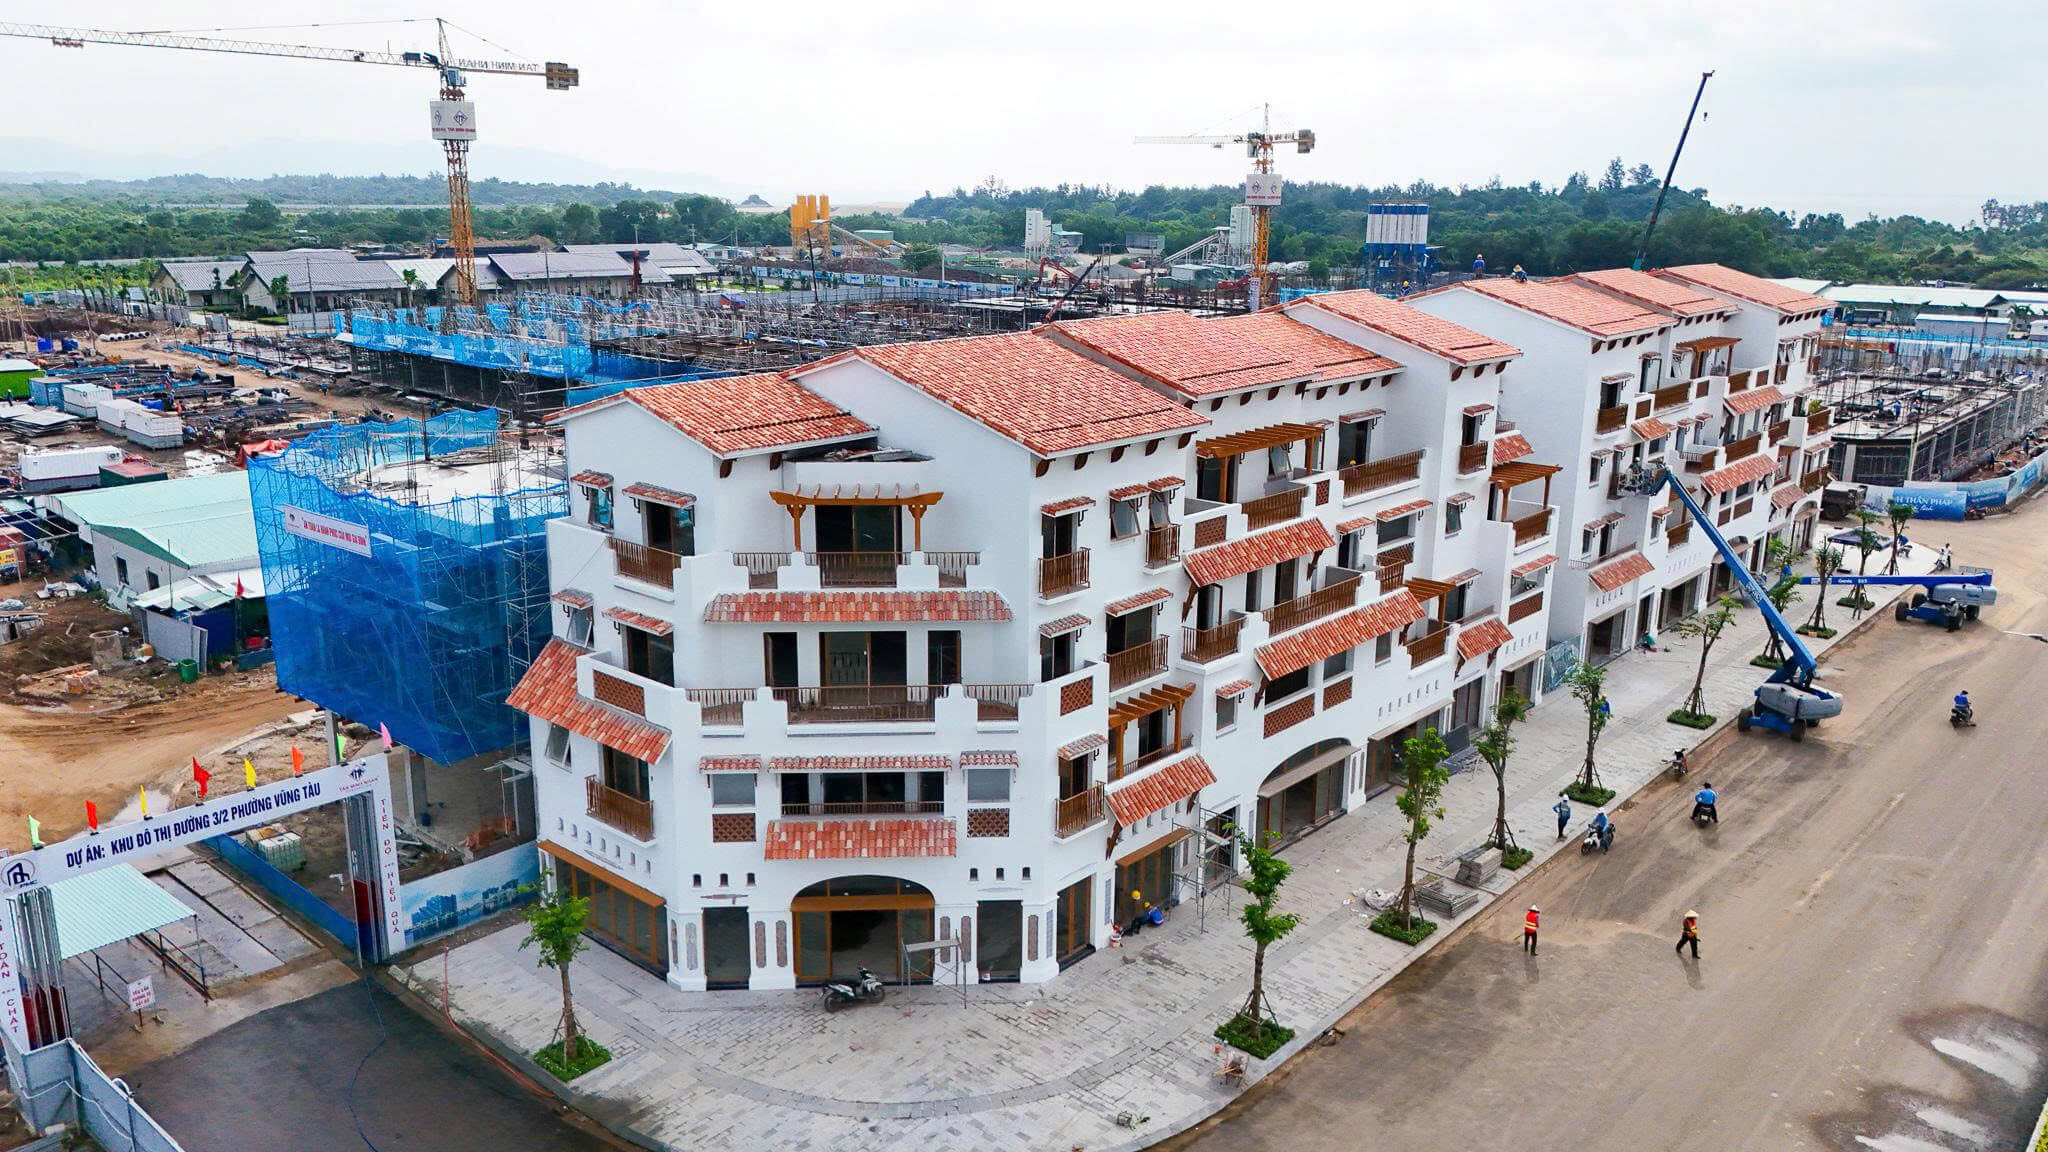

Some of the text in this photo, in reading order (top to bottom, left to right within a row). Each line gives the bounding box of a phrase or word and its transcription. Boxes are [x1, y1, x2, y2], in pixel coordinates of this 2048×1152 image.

[66, 850, 83, 869] DỰ
[86, 844, 105, 863] ÁN:
[110, 836, 134, 855] KHU
[153, 826, 173, 842] THỊ
[174, 815, 211, 837] ĐƯỜNG
[212, 809, 229, 826] 3/2
[231, 797, 273, 821] PHƯỜNG
[274, 789, 301, 808] VŨNG
[302, 782, 321, 800] TÀU
